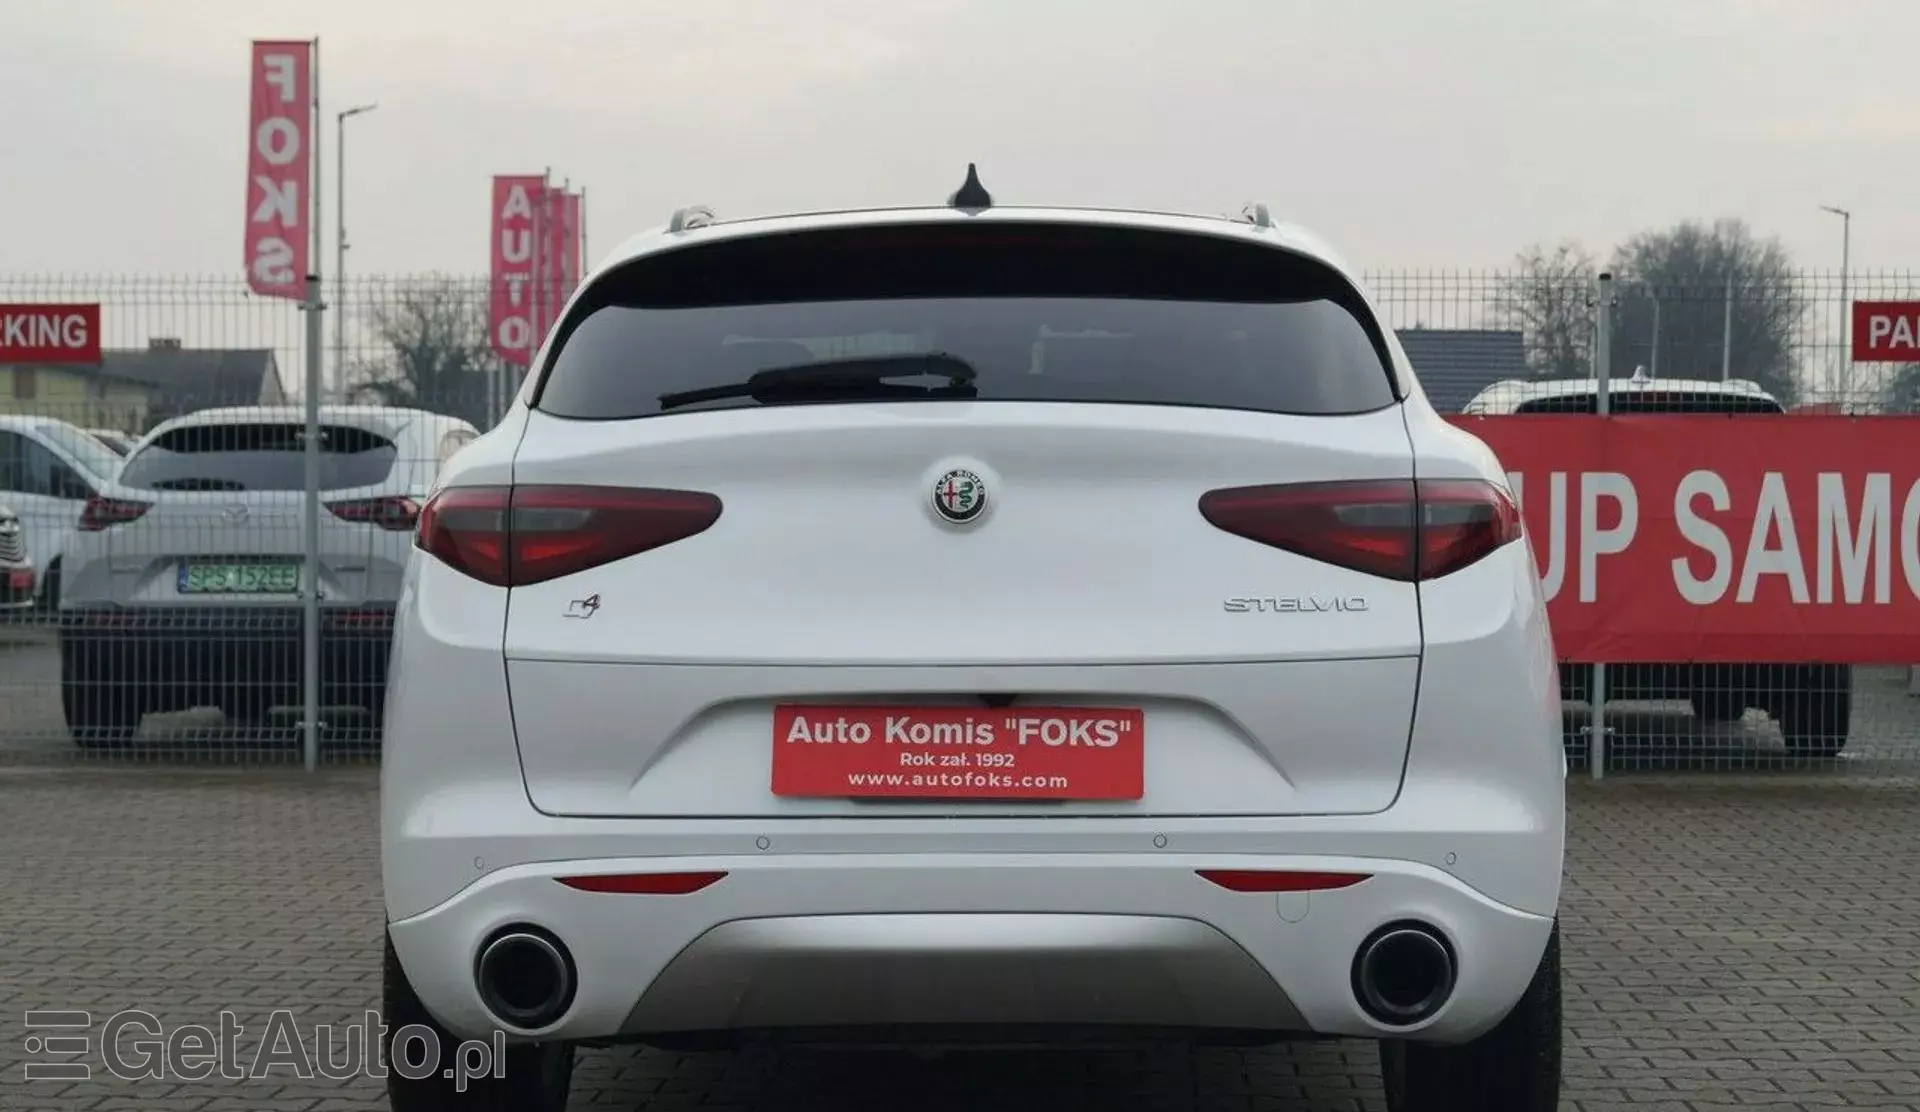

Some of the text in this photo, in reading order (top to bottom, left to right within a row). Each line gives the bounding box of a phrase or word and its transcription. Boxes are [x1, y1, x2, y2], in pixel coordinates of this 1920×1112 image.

[499, 184, 532, 349] AUTO
[0, 313, 88, 349] KING
[1869, 315, 1920, 349] PA
[1671, 469, 1920, 605] SAM
[1224, 597, 1368, 612] STELVIO
[786, 715, 1131, 747] Auto Komis "FOKS"
[900, 752, 1015, 768] Rok zał. 1992
[848, 772, 1068, 788] www.autofoks.com
